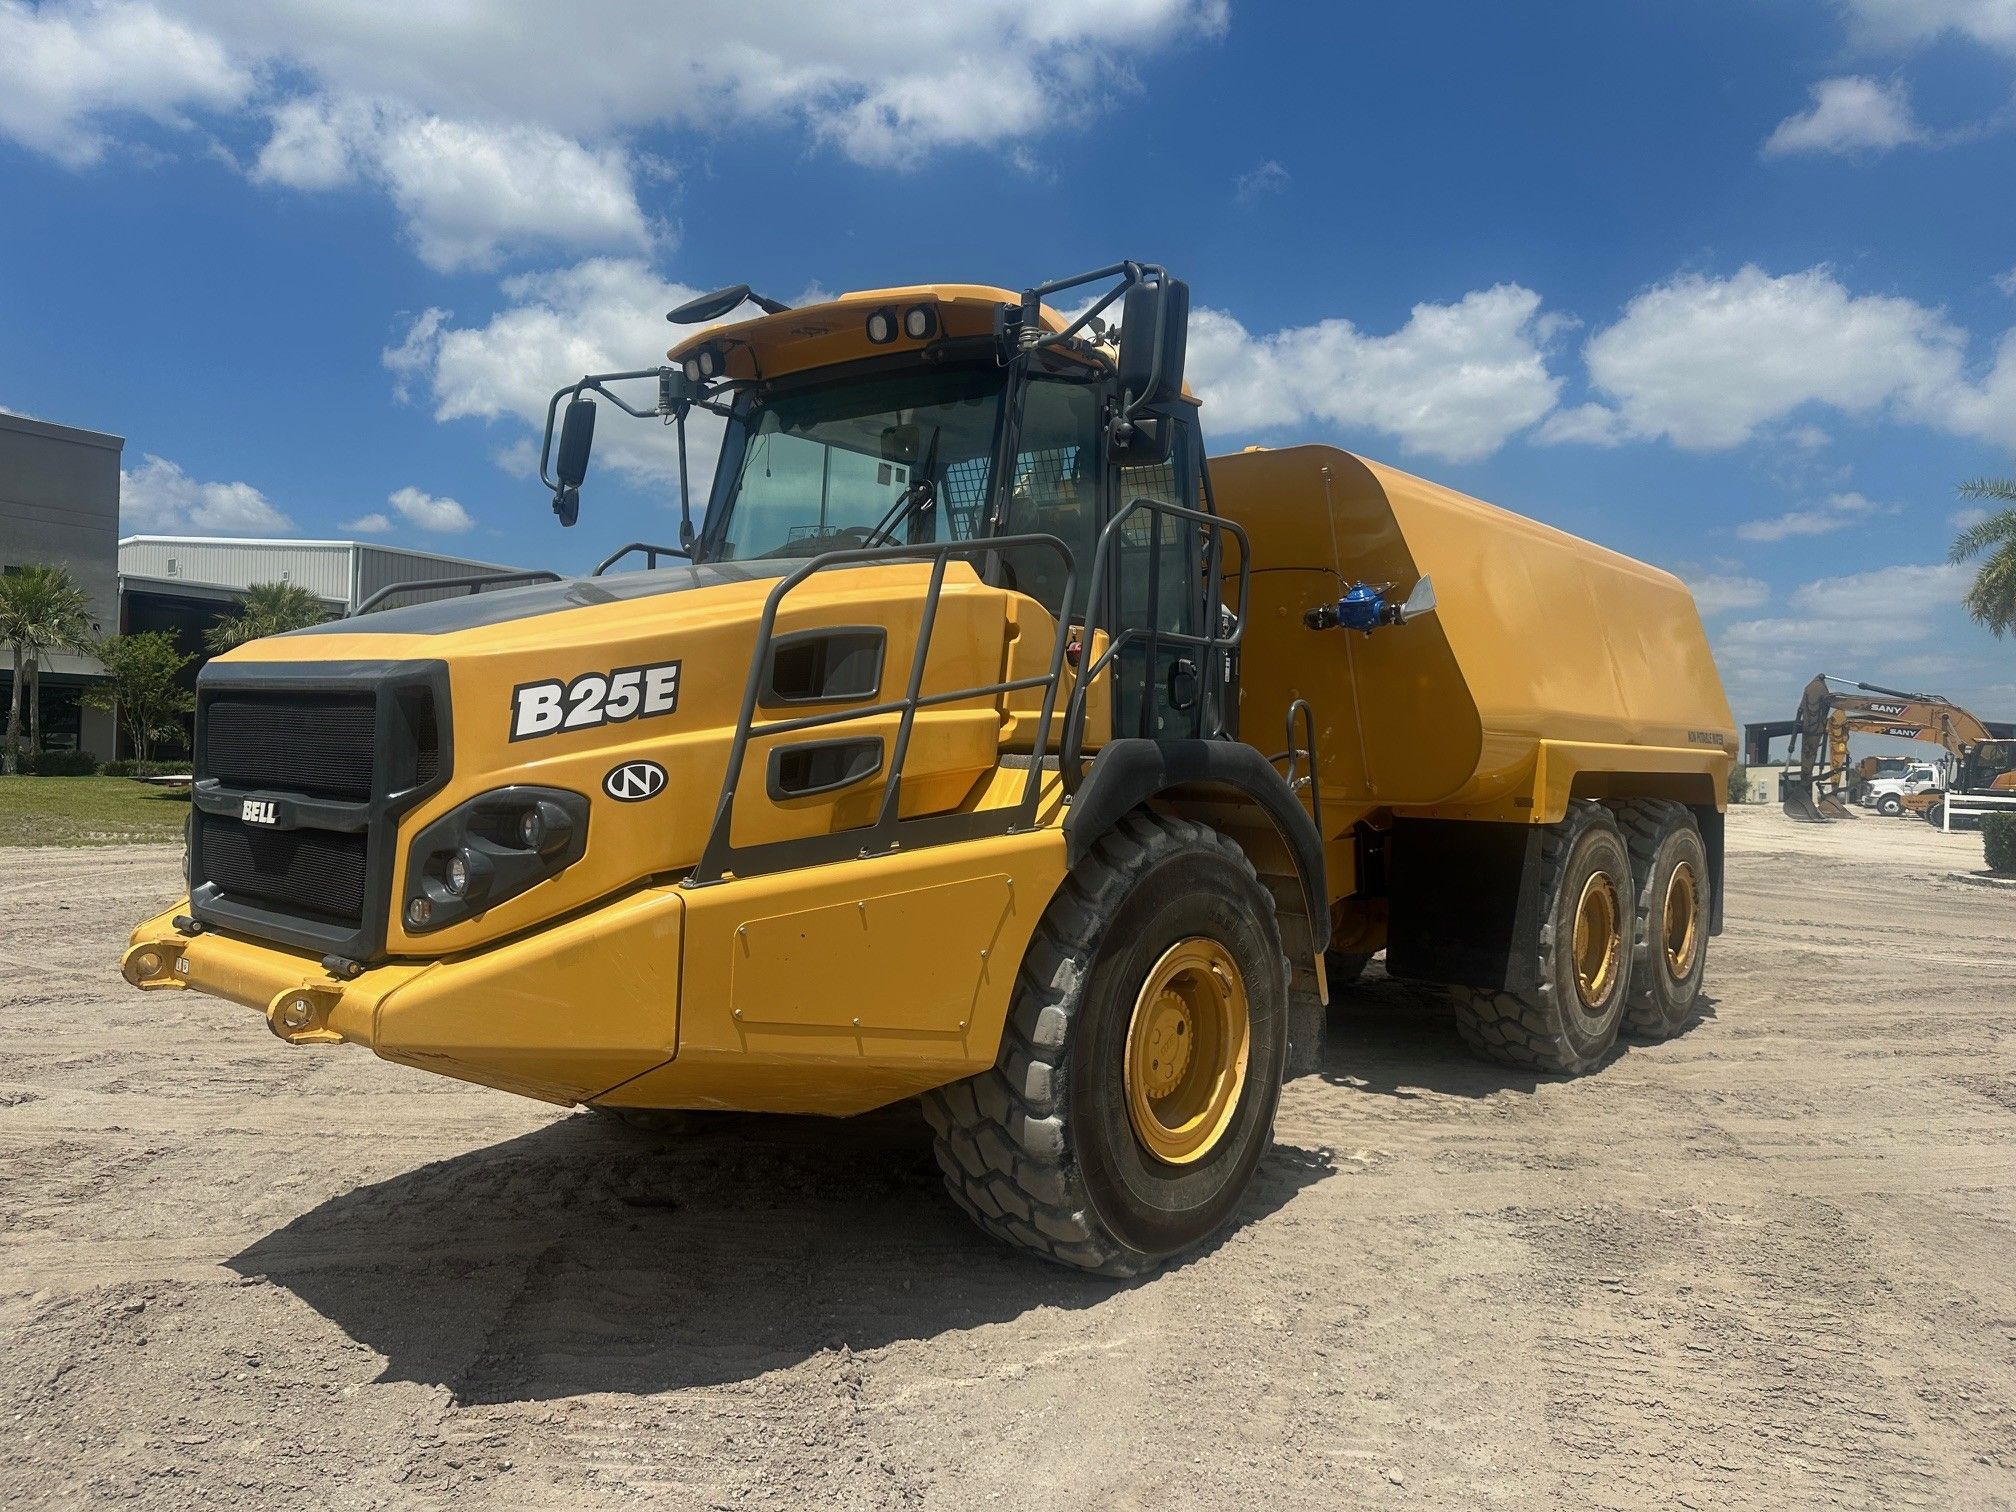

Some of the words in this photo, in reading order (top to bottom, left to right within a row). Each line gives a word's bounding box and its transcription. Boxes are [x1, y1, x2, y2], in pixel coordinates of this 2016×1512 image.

[514, 664, 678, 738] B25E
[1870, 703, 1902, 714] SANY
[1889, 728, 1917, 737] SANY
[241, 800, 276, 824] BELL
